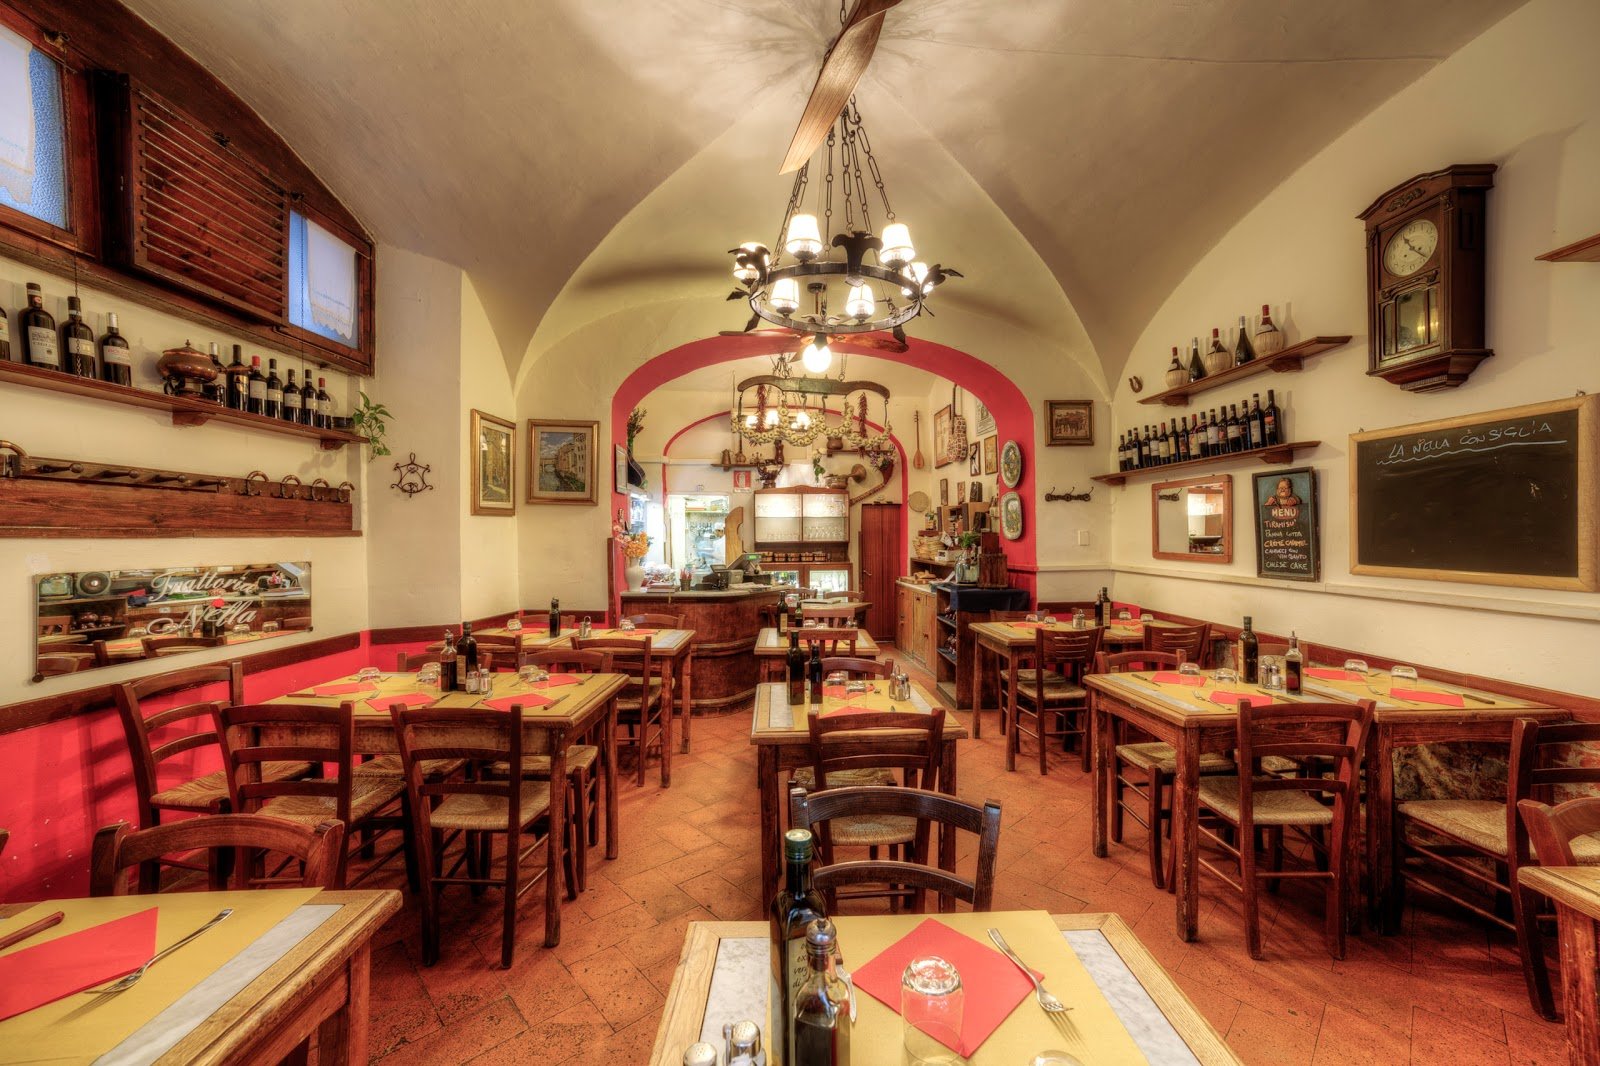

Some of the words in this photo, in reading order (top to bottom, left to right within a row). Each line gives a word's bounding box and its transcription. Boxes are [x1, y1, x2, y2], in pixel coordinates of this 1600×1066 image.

[1389, 444, 1404, 458] LA
[1271, 508, 1297, 517] MENU
[148, 570, 257, 602] Trattoria
[146, 600, 258, 636] Nella
